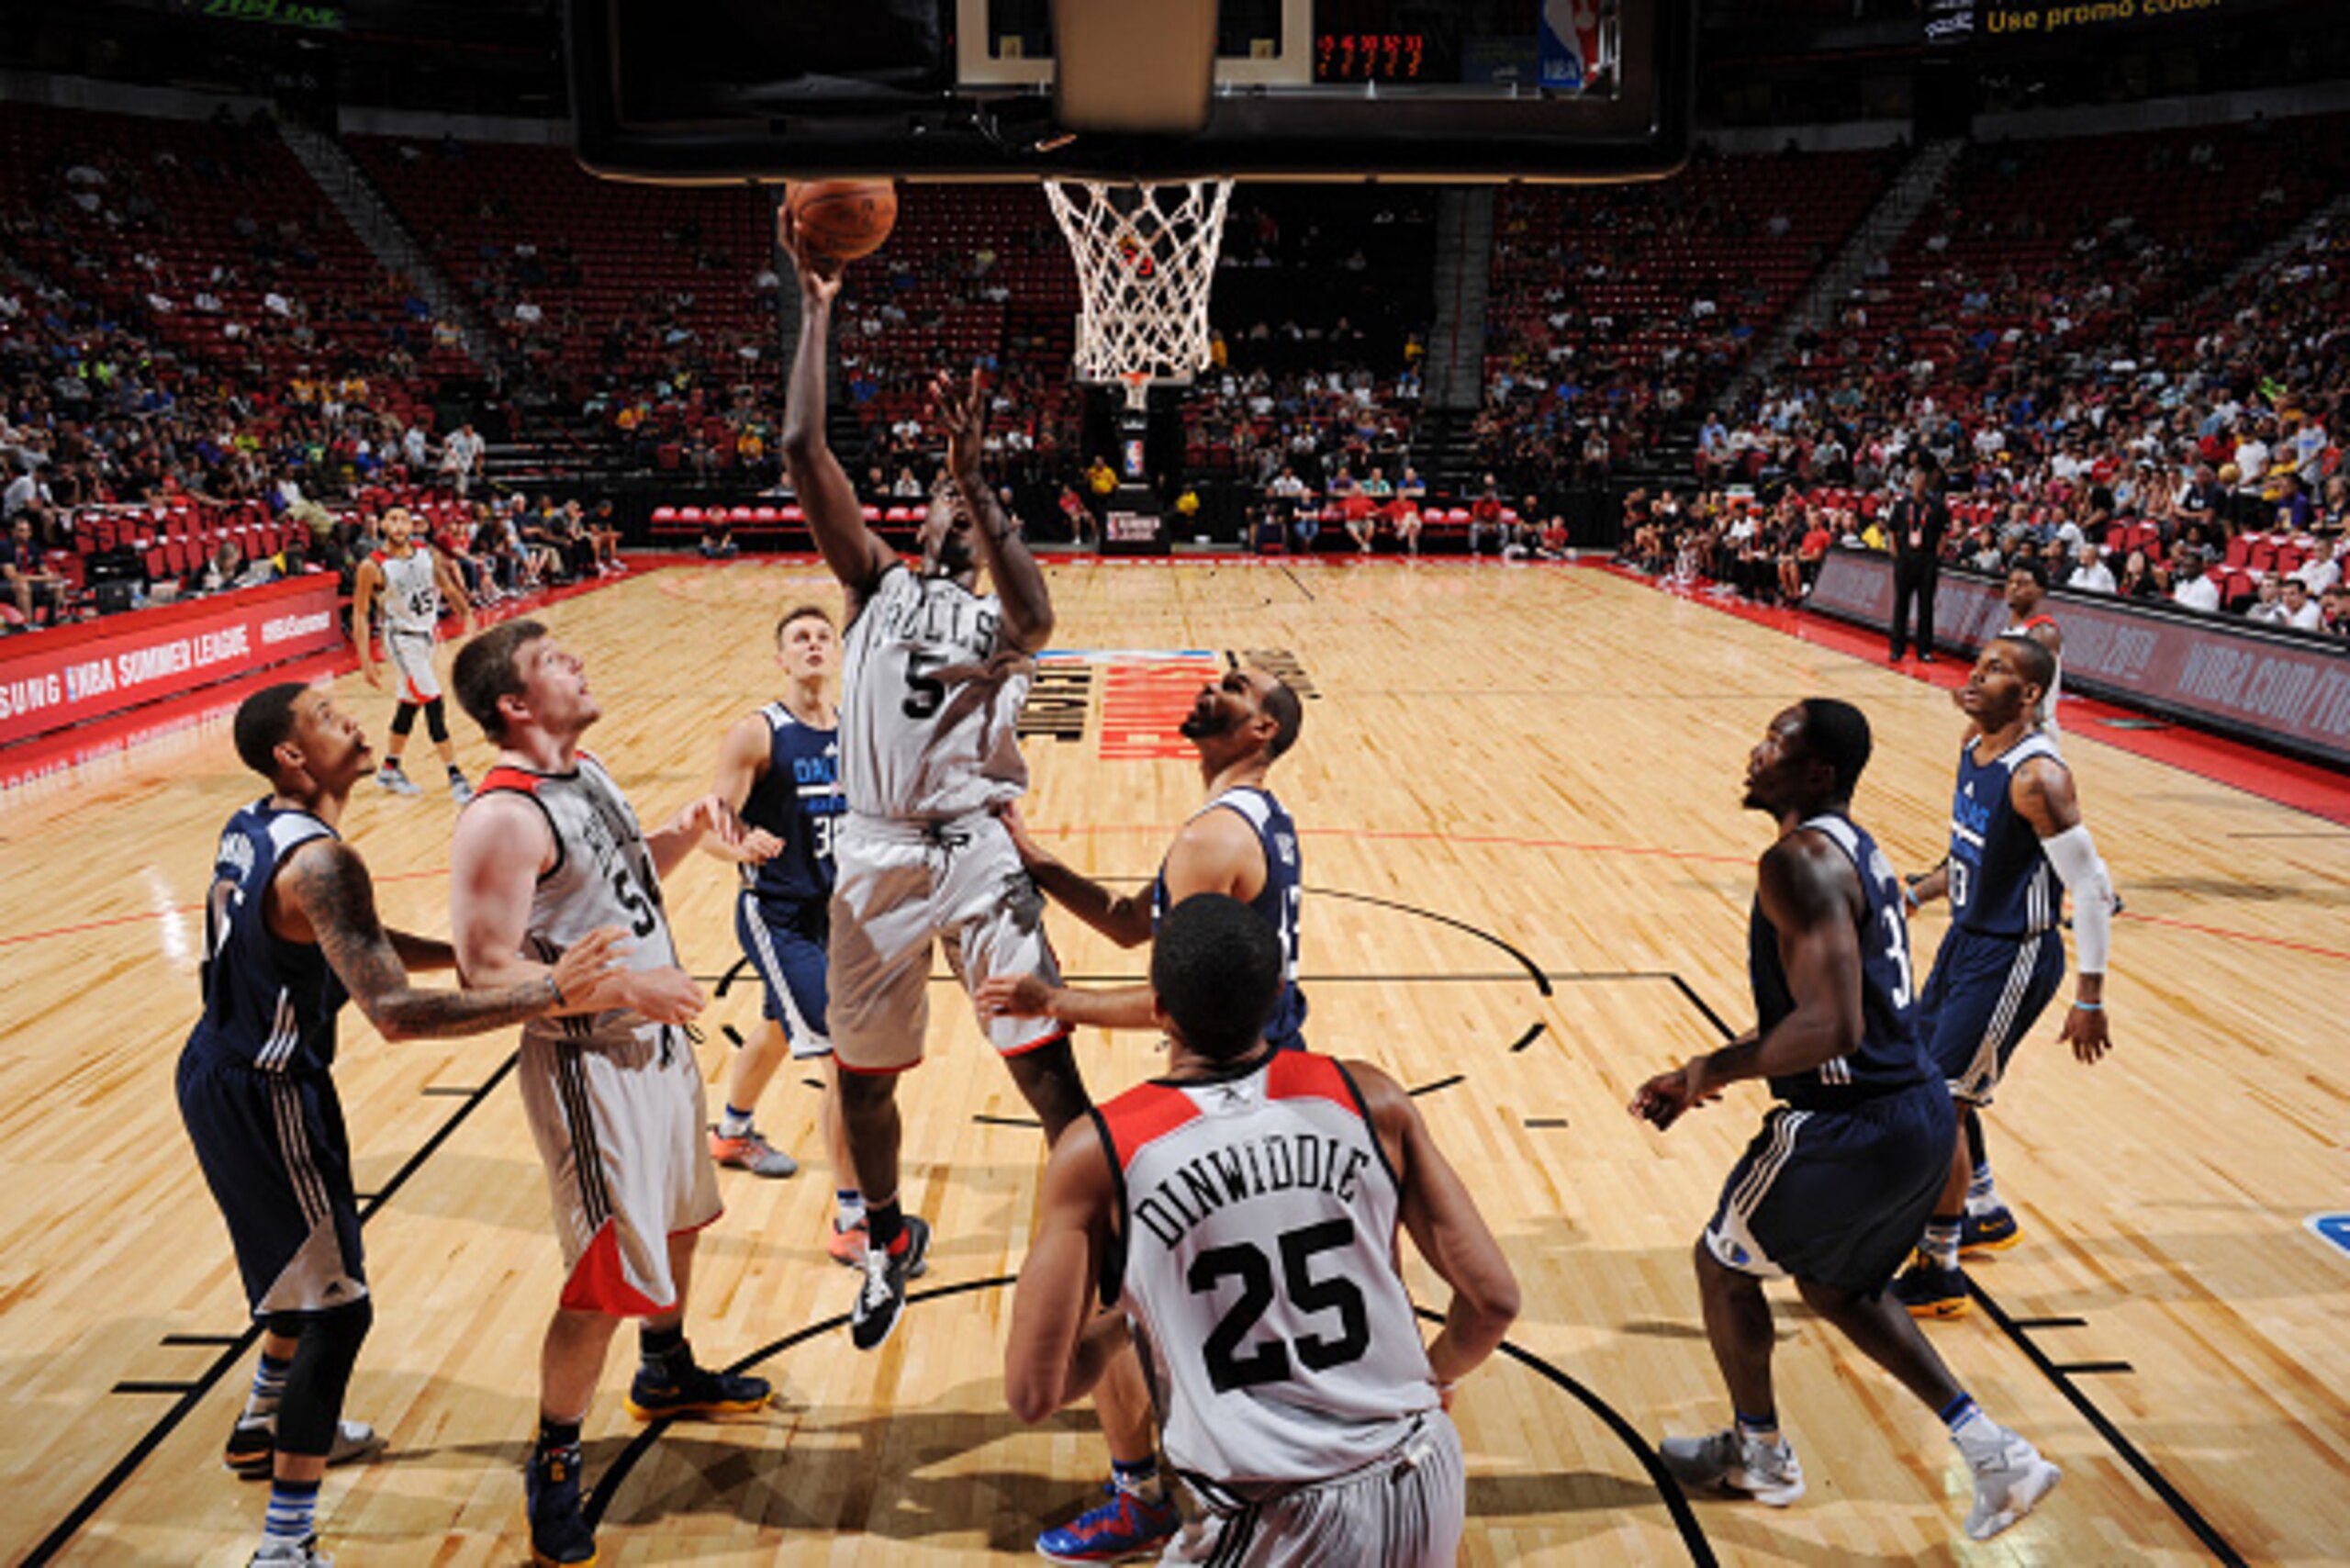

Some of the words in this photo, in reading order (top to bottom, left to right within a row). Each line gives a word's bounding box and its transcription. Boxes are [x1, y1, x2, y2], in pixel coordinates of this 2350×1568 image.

[1987, 10, 2038, 33] Use
[2045, 0, 2133, 32] promo
[409, 588, 433, 616] 45
[0, 674, 61, 720] SUNG
[77, 660, 116, 699] NBA
[118, 639, 191, 688] SUMMER
[194, 623, 250, 667] LEAGUE
[901, 651, 949, 720] 5
[1134, 1134, 1371, 1251] DINWIDDIE
[1186, 1216, 1371, 1394] 25
